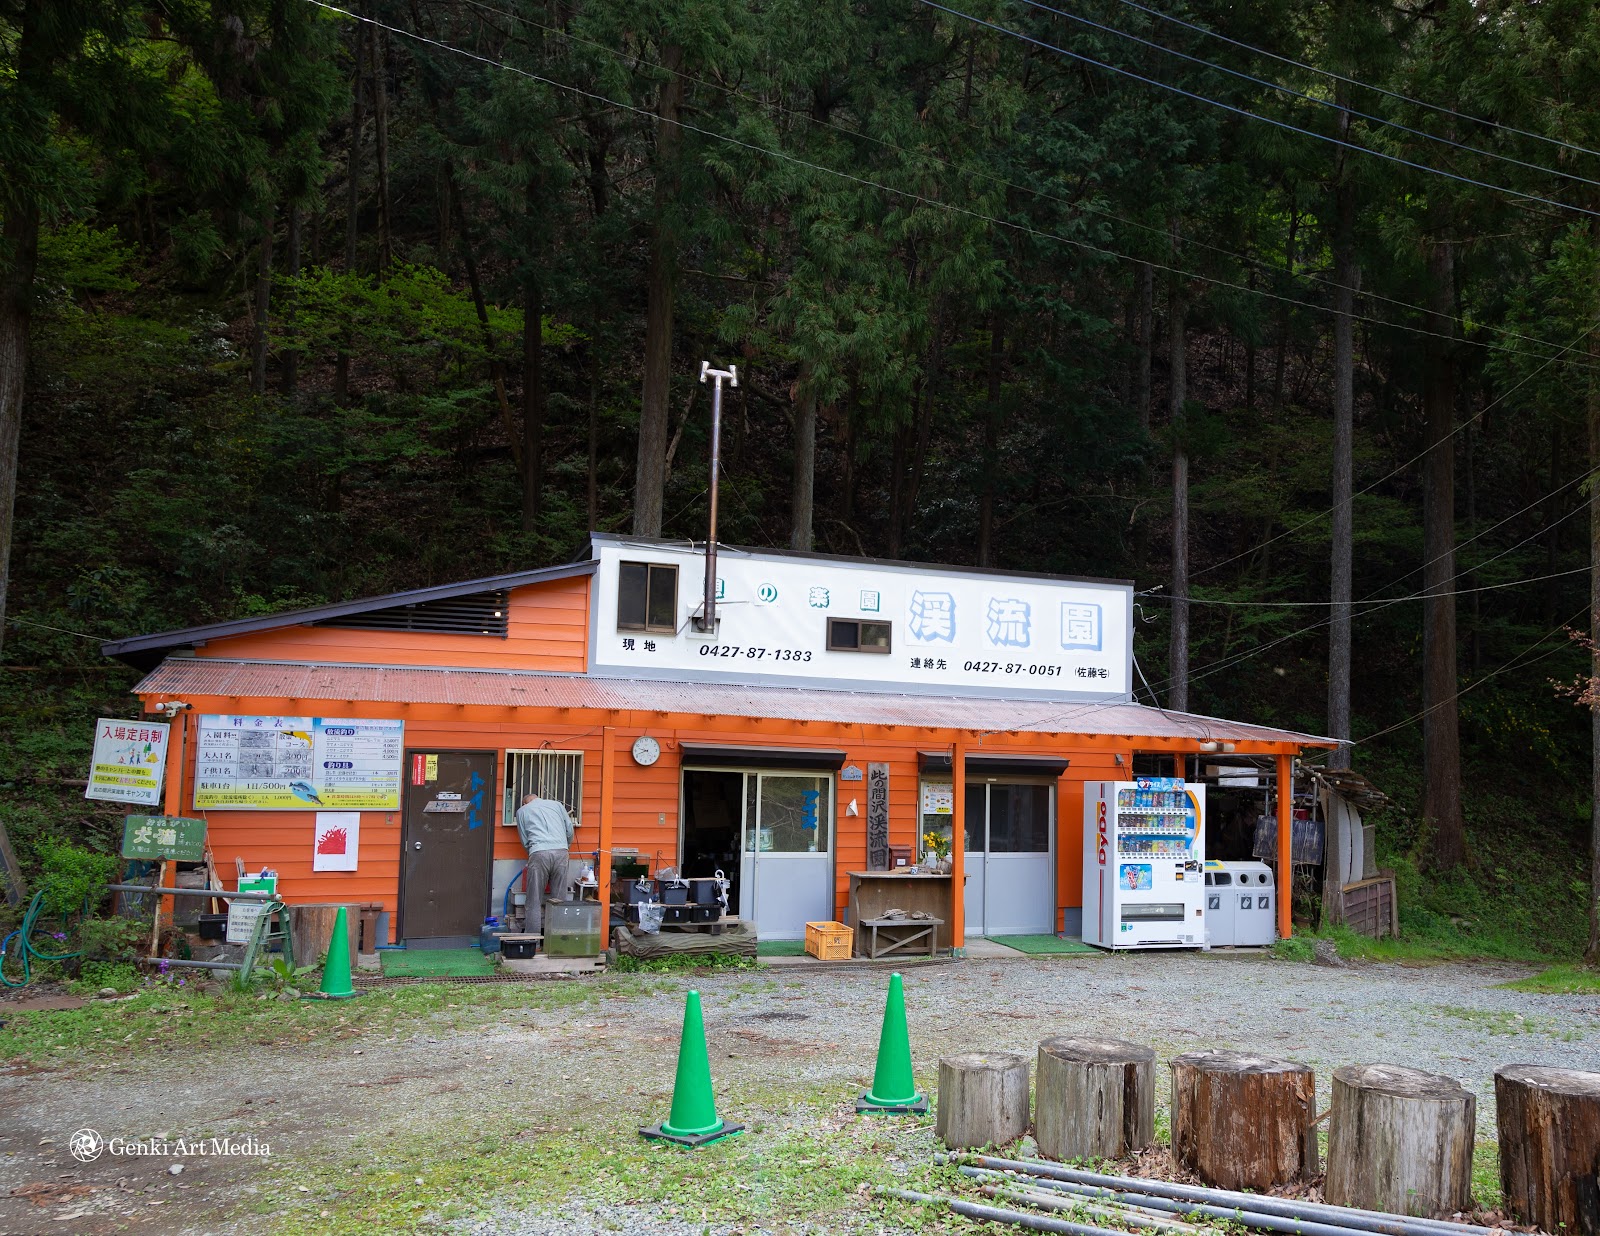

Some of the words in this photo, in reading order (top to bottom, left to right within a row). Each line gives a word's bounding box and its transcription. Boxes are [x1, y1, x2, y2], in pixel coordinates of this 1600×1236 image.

[909, 590, 1102, 651] 渓流園
[622, 638, 656, 652] 現地
[699, 644, 813, 662] 0427-87-1383
[910, 657, 947, 670] 連絡先
[963, 661, 1062, 677] 0427-87-0051
[233, 718, 283, 728] 料金表
[102, 726, 162, 743] 入場定員制
[246, 782, 286, 790] 1日/500円
[468, 771, 486, 831] トイレ
[801, 789, 820, 831] アイス
[146, 818, 190, 828] おねがい
[869, 769, 889, 868] 此の間沢渓流園
